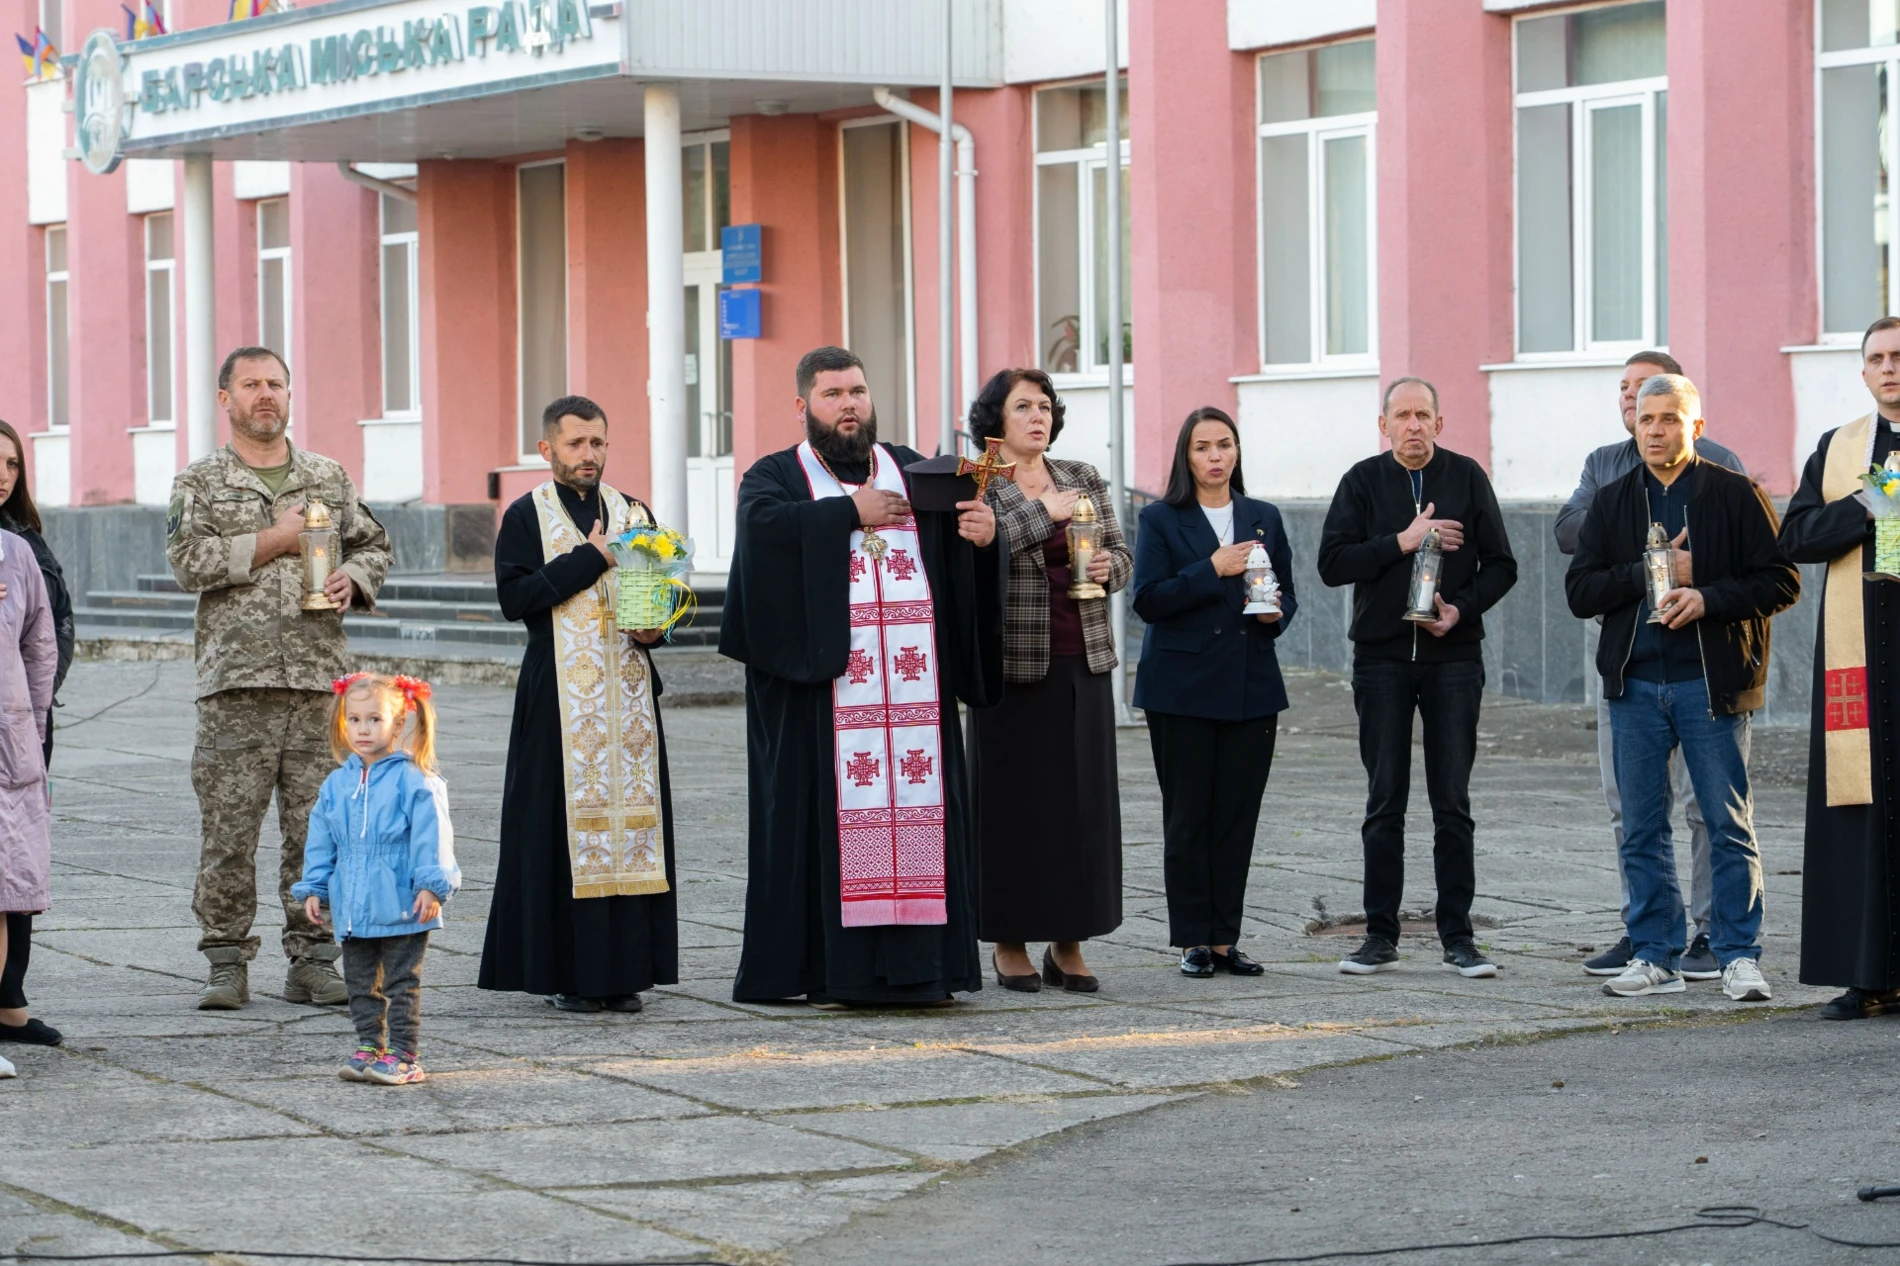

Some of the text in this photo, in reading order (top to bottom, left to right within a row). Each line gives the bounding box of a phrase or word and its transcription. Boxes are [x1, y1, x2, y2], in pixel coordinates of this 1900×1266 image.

[141, 0, 590, 112] БАРСЬКА МІСЬКА РАДА
